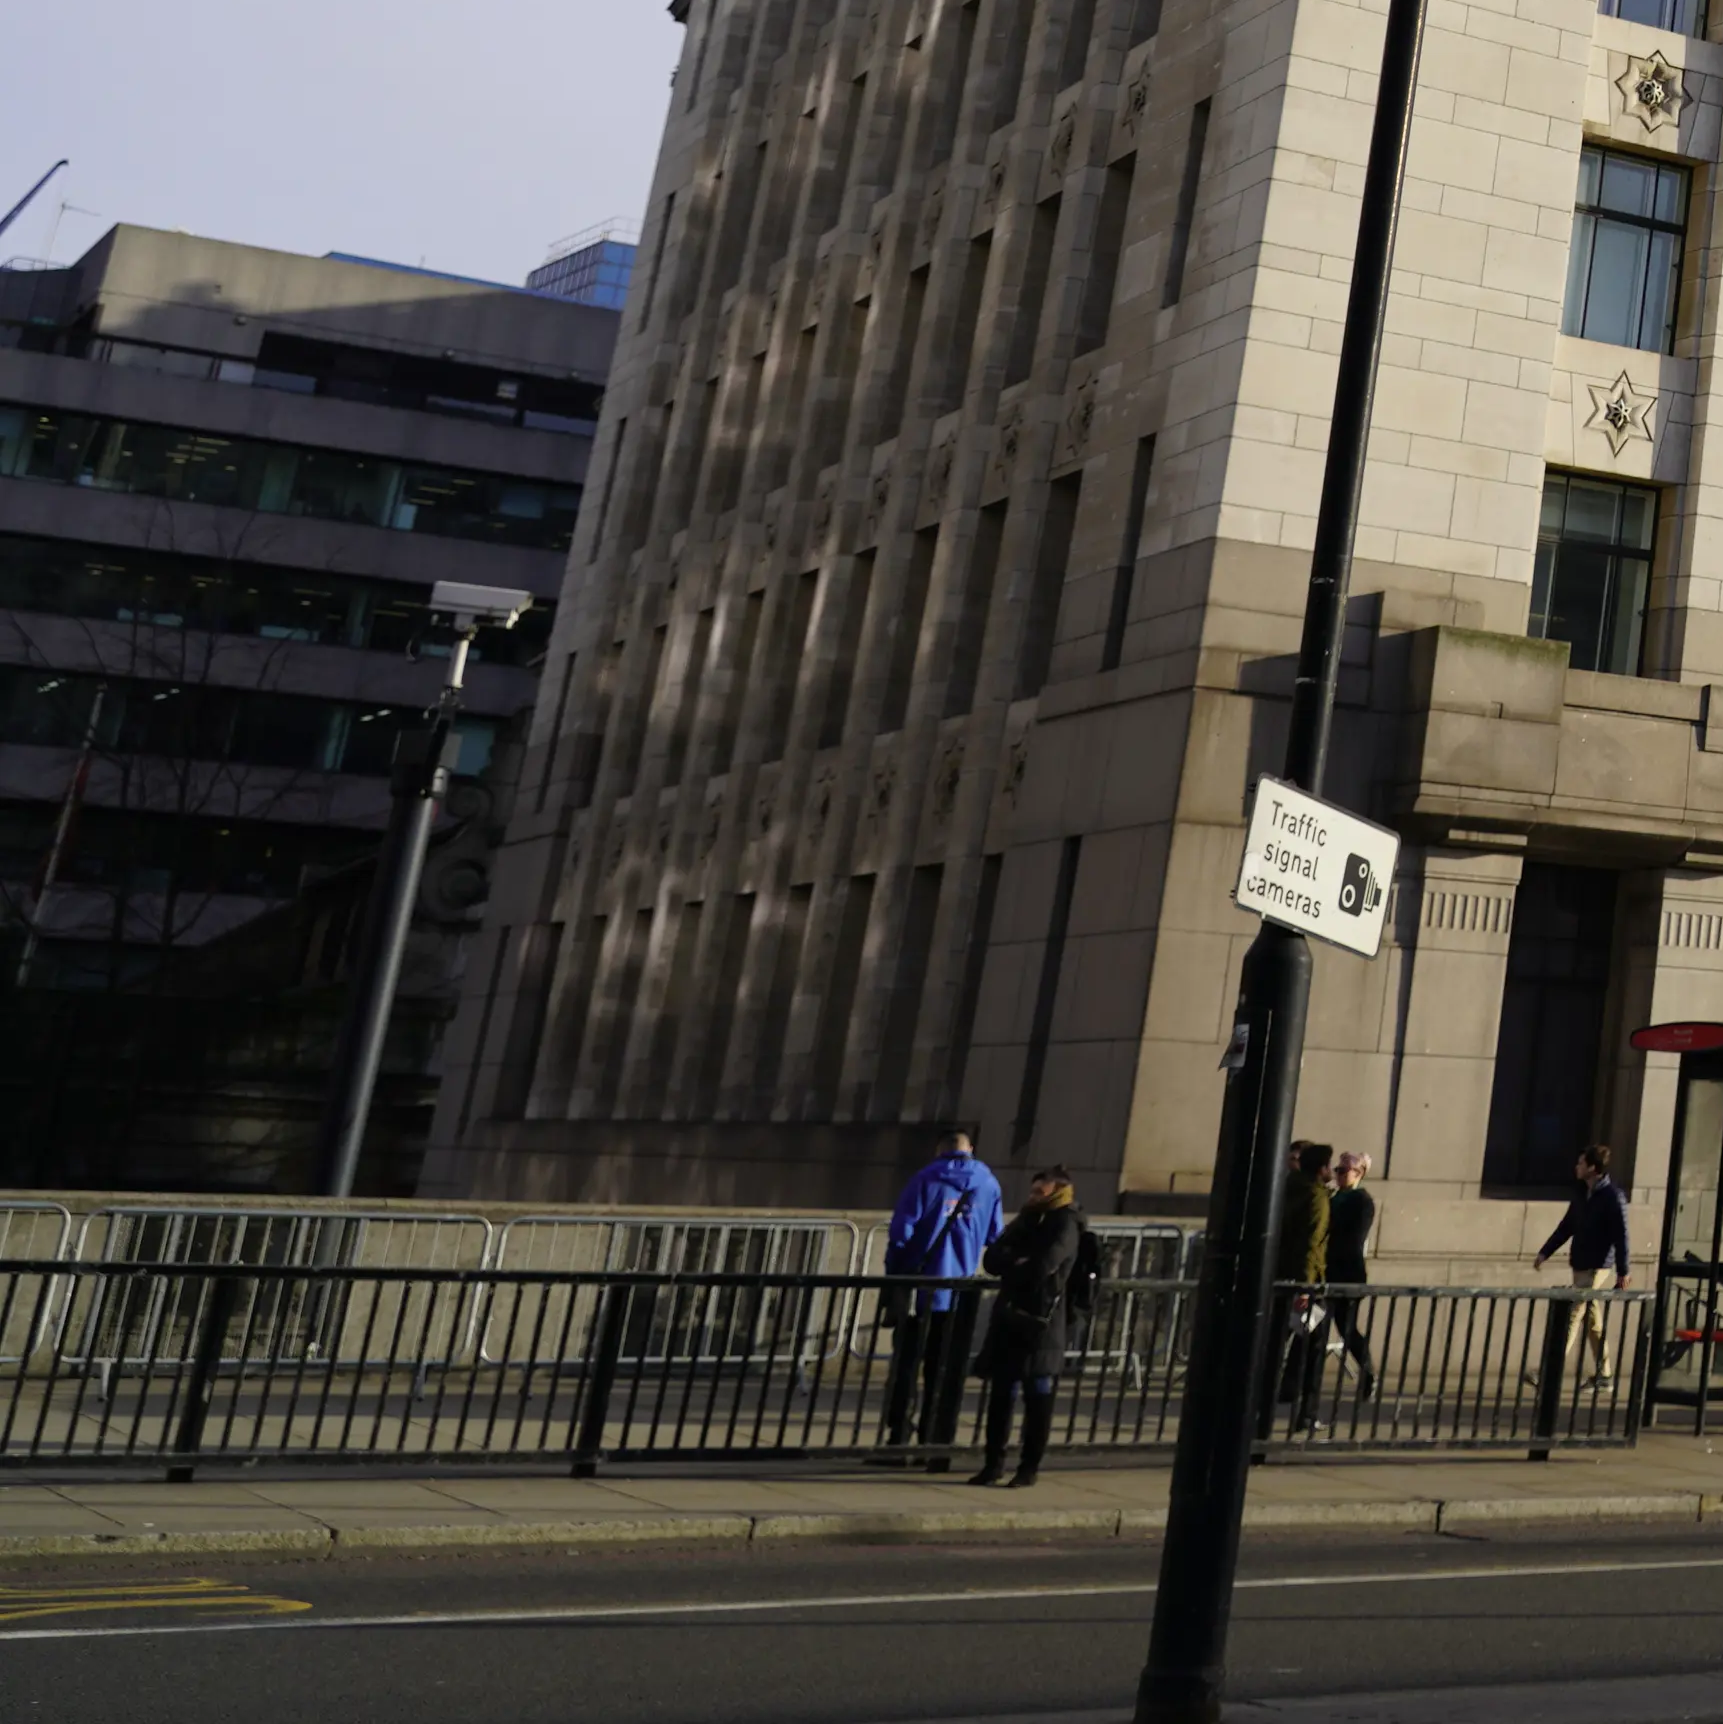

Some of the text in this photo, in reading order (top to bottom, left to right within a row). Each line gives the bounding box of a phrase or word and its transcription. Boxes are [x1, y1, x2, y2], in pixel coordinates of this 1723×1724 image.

[1271, 800, 1328, 847] Traffic
[1263, 840, 1319, 881] signal
[1247, 876, 1322, 918] cameras
